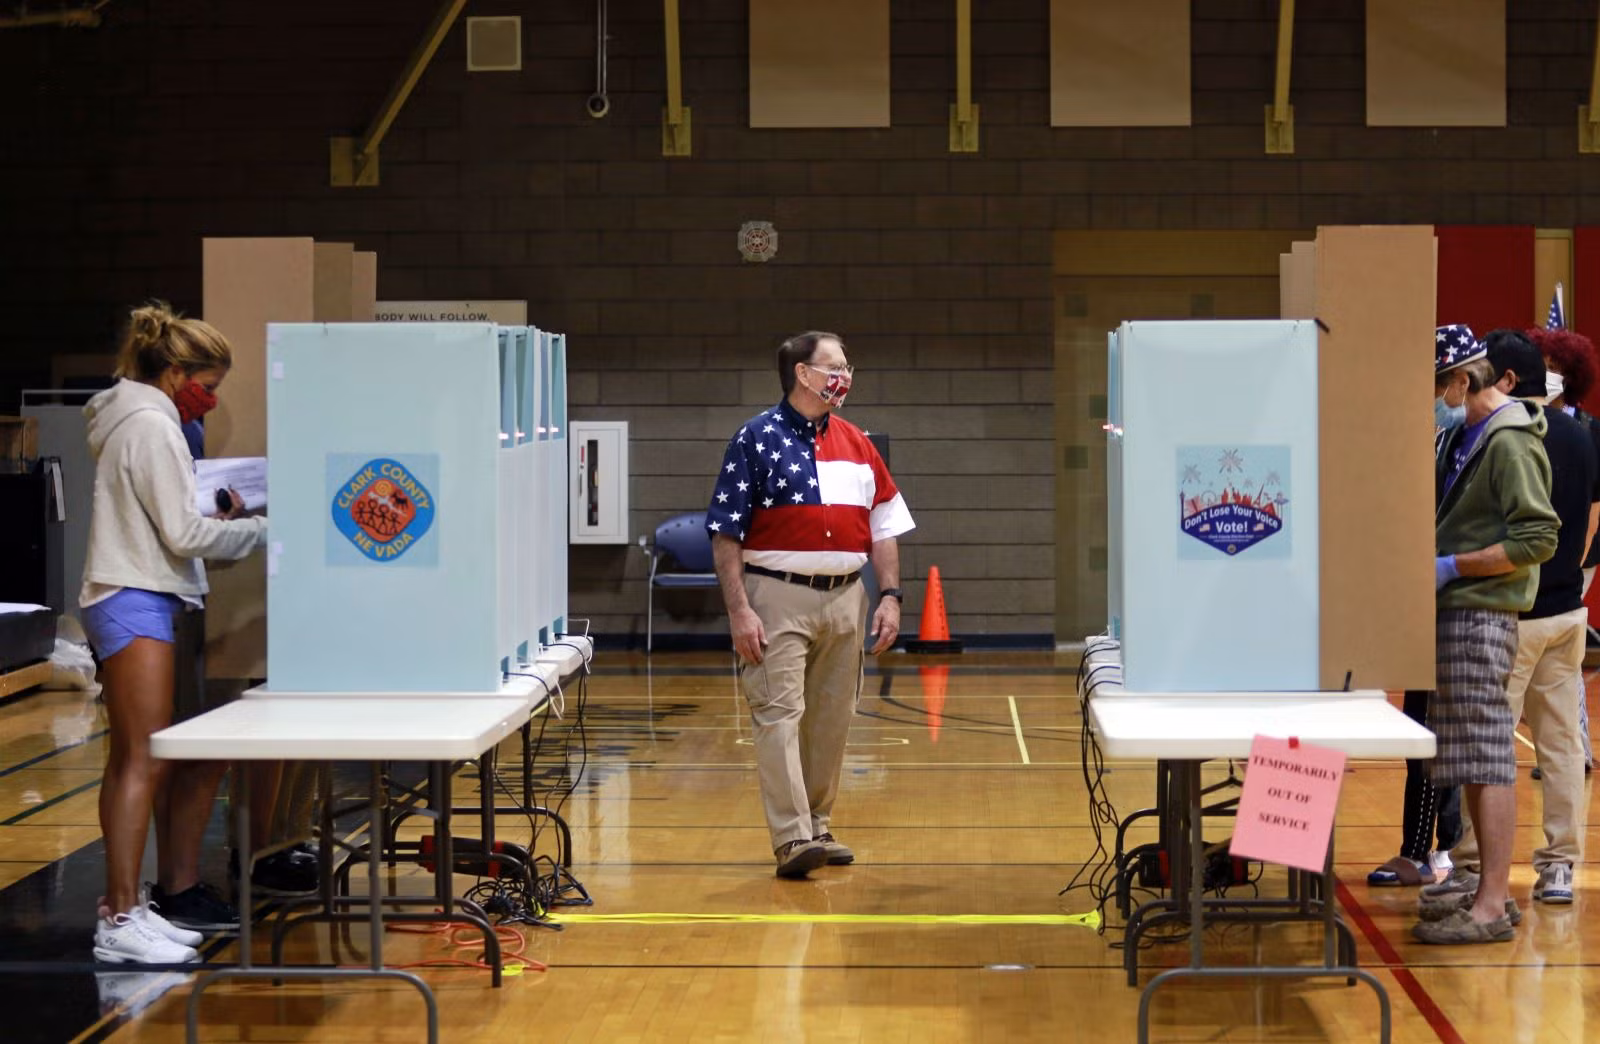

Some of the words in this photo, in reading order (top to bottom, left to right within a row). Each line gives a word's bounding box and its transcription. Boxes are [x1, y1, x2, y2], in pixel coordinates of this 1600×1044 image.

[409, 313, 434, 321] WILL
[440, 313, 490, 321] FOLLOW.
[338, 467, 377, 509] CLARK
[381, 463, 429, 509] COUNTY
[1184, 512, 1208, 530] Don't
[1209, 506, 1230, 518] Lose
[1232, 504, 1253, 518] Your
[1255, 510, 1278, 529] Voice
[1215, 521, 1248, 533] Vote!
[1253, 756, 1338, 781] TEMPORARILY
[1267, 787, 1293, 800] OUT
[1295, 794, 1311, 804] OF
[1259, 812, 1309, 831] SERVICE
